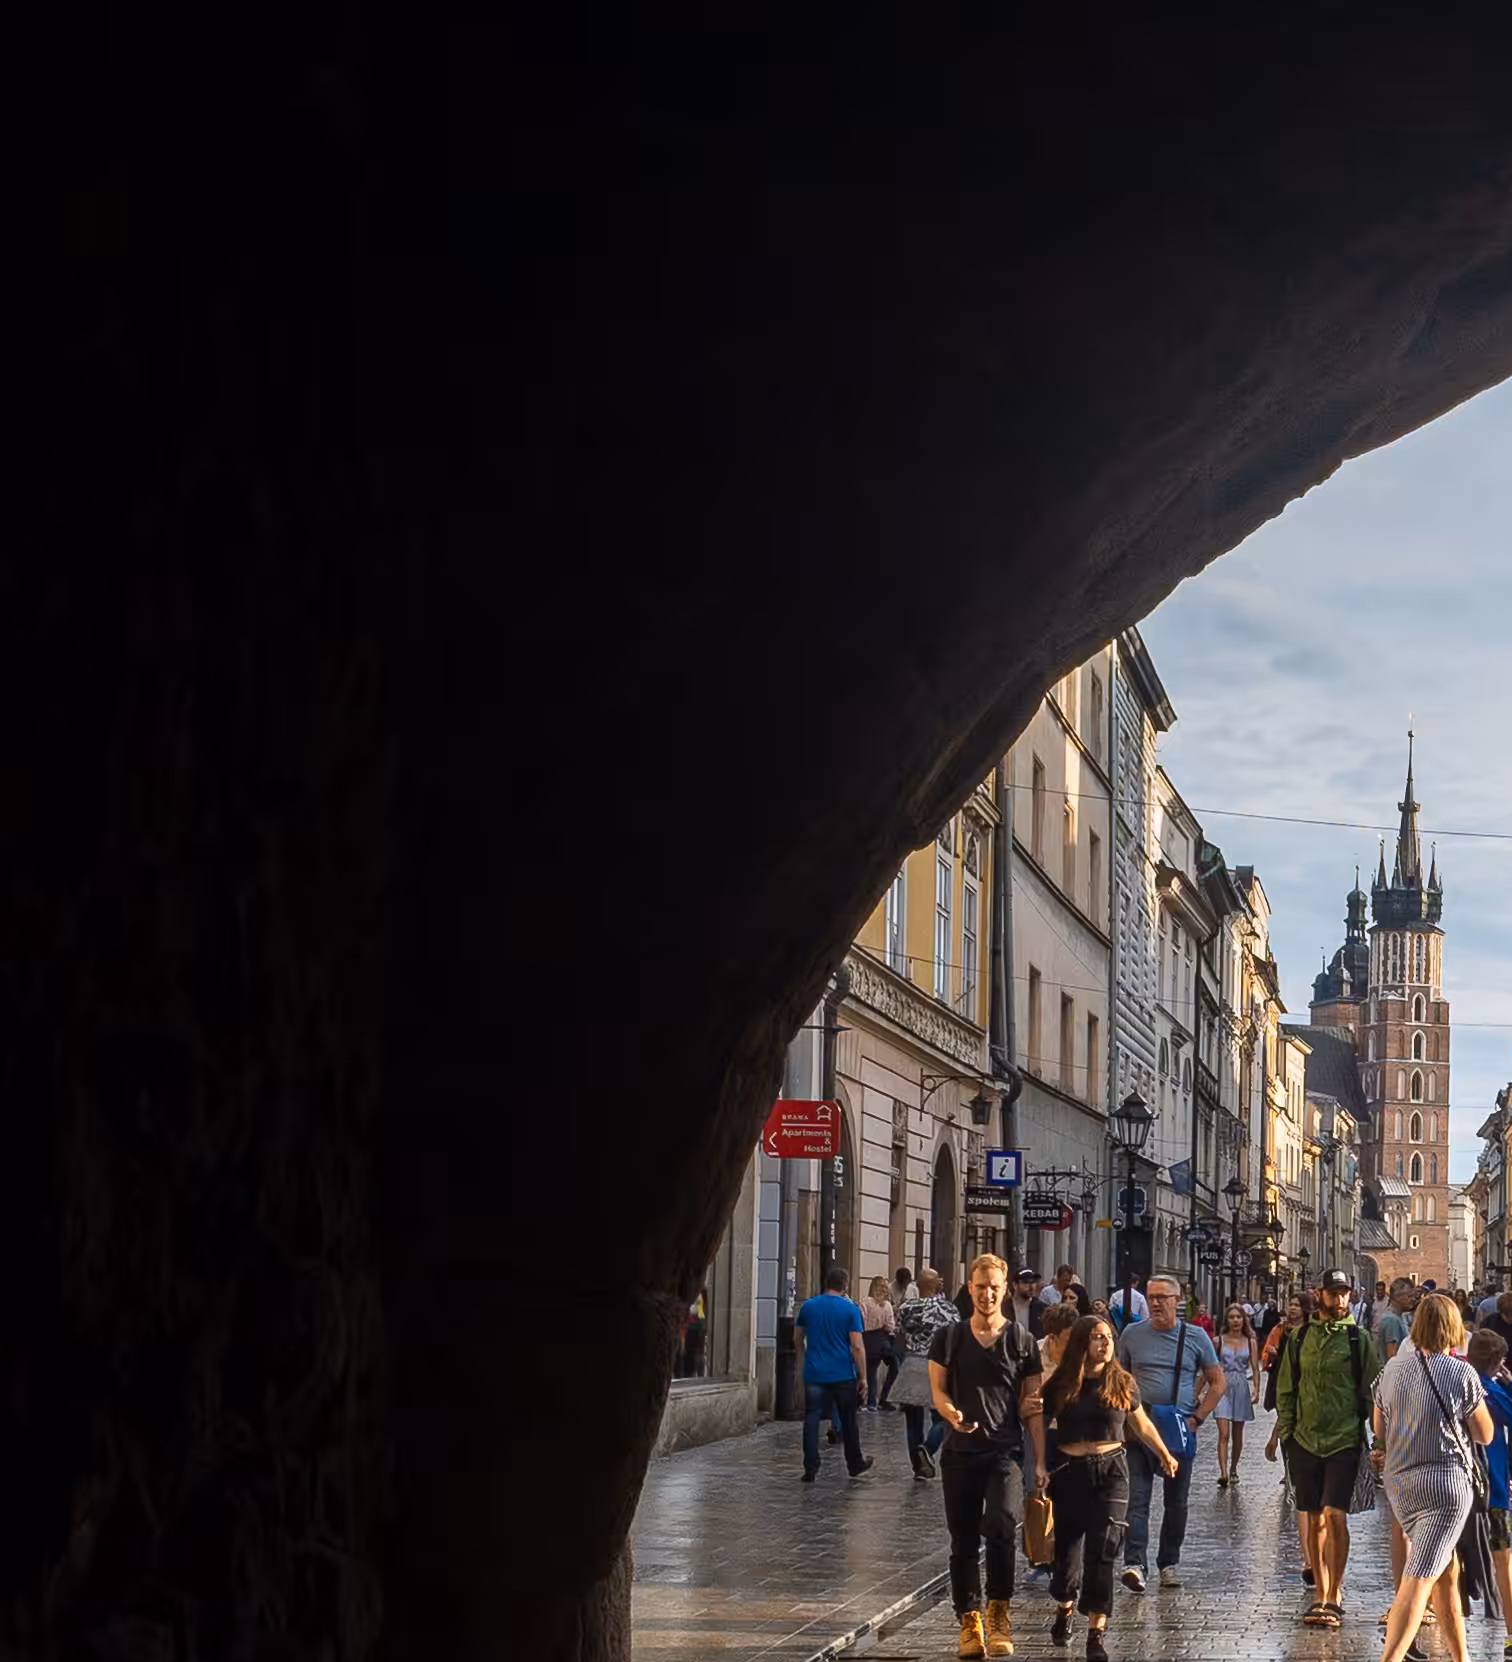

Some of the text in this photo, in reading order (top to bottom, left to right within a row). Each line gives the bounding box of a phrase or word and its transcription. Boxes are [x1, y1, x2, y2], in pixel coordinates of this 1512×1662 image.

[781, 1128, 832, 1138] Apartments
[803, 1145, 832, 1153] Hostel
[1024, 1209, 1060, 1218] KEBAB
